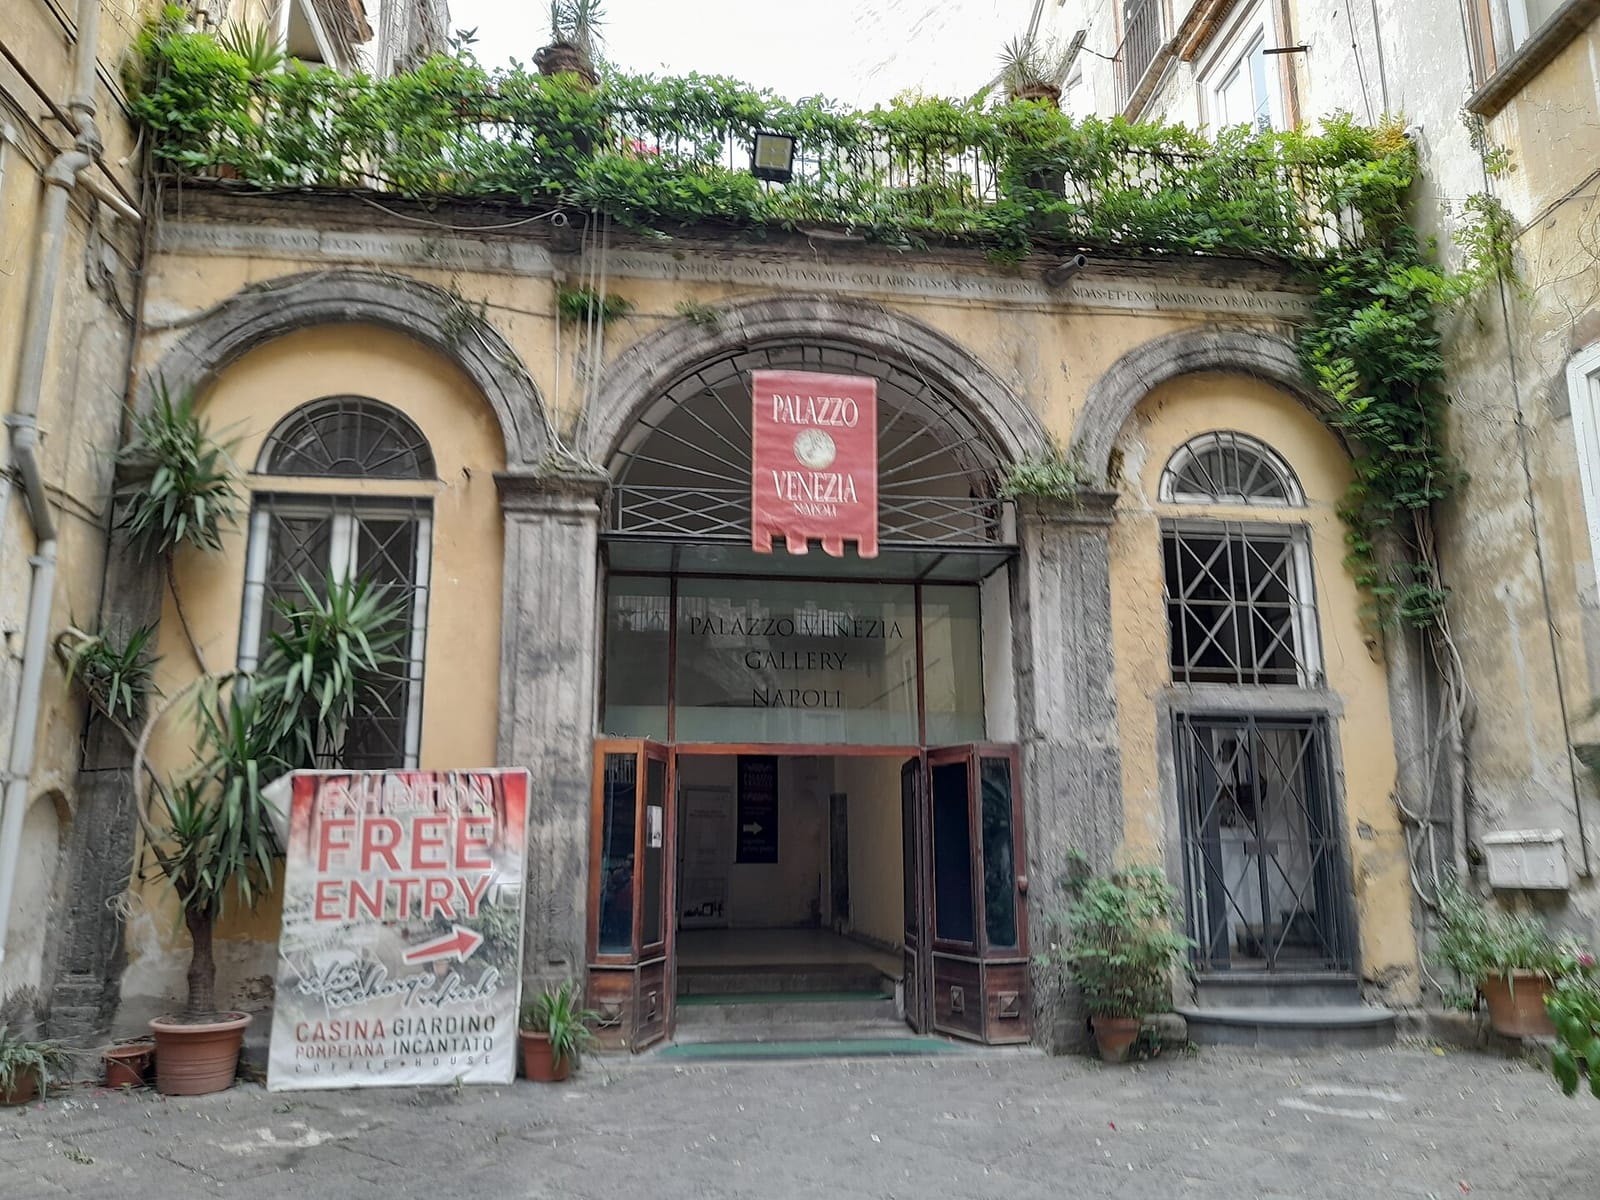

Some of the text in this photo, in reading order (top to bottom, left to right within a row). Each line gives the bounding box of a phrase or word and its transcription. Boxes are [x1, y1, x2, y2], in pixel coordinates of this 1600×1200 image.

[772, 394, 859, 428] PALAZZO
[772, 470, 858, 503] VENEZIA
[793, 503, 838, 517] NAPOLI
[690, 616, 904, 639] PALAZZO VENEZIA
[745, 651, 848, 671] GALLERY
[752, 688, 841, 709] NAPOLI
[317, 816, 493, 873] FREE
[314, 874, 492, 921] ENTRY
[296, 1015, 496, 1042] CASINA GIARDINO
[295, 1036, 494, 1059] POMPEIANA INCANTATO
[415, 1055, 491, 1067] HOUSE
